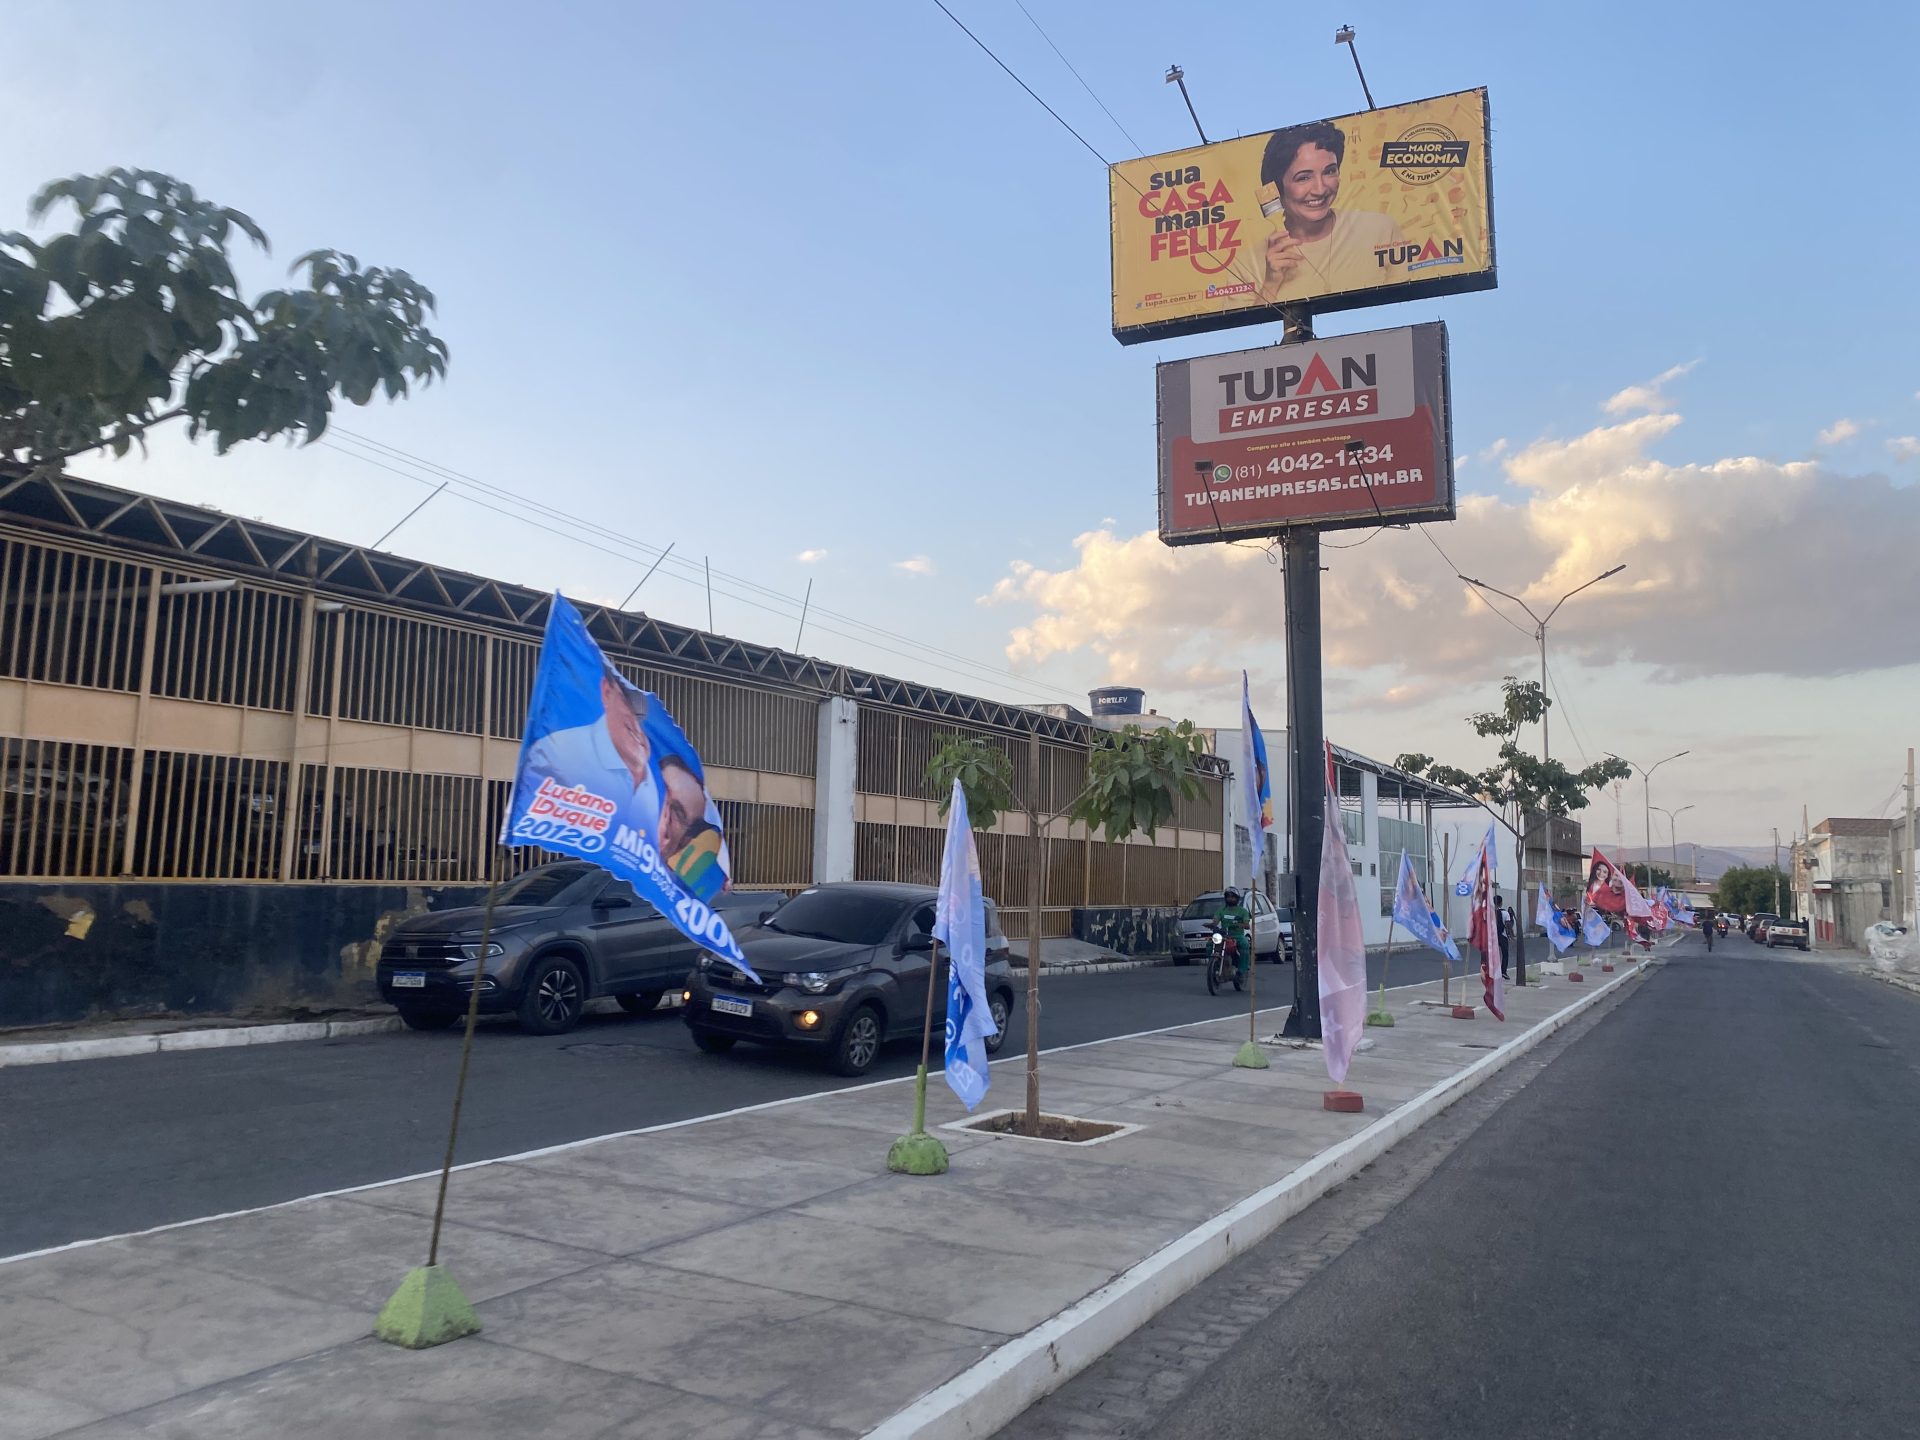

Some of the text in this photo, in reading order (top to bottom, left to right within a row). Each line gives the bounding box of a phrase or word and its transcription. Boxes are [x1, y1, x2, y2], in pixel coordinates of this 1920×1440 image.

[1386, 153, 1460, 165] ECONOMIA
[1408, 144, 1442, 152] MAIOR
[1150, 165, 1201, 191] sua
[1405, 173, 1415, 181] NA
[1417, 169, 1441, 181] TUPAN
[1138, 178, 1234, 218] CASA
[1155, 201, 1226, 234] mais
[1151, 218, 1242, 262] FELIZ
[1374, 237, 1463, 268] TUPAN
[1145, 293, 1198, 308] tupan.com.br
[1218, 351, 1377, 406] TUPAN
[1230, 394, 1370, 428] EMPRESAS
[1235, 444, 1393, 482] (81) 4042-1234
[1184, 468, 1423, 507] TUPANEMPRESAS.COM.BR
[538, 778, 615, 815] Luciano
[529, 796, 608, 832] Duque
[514, 817, 604, 852] 20120
